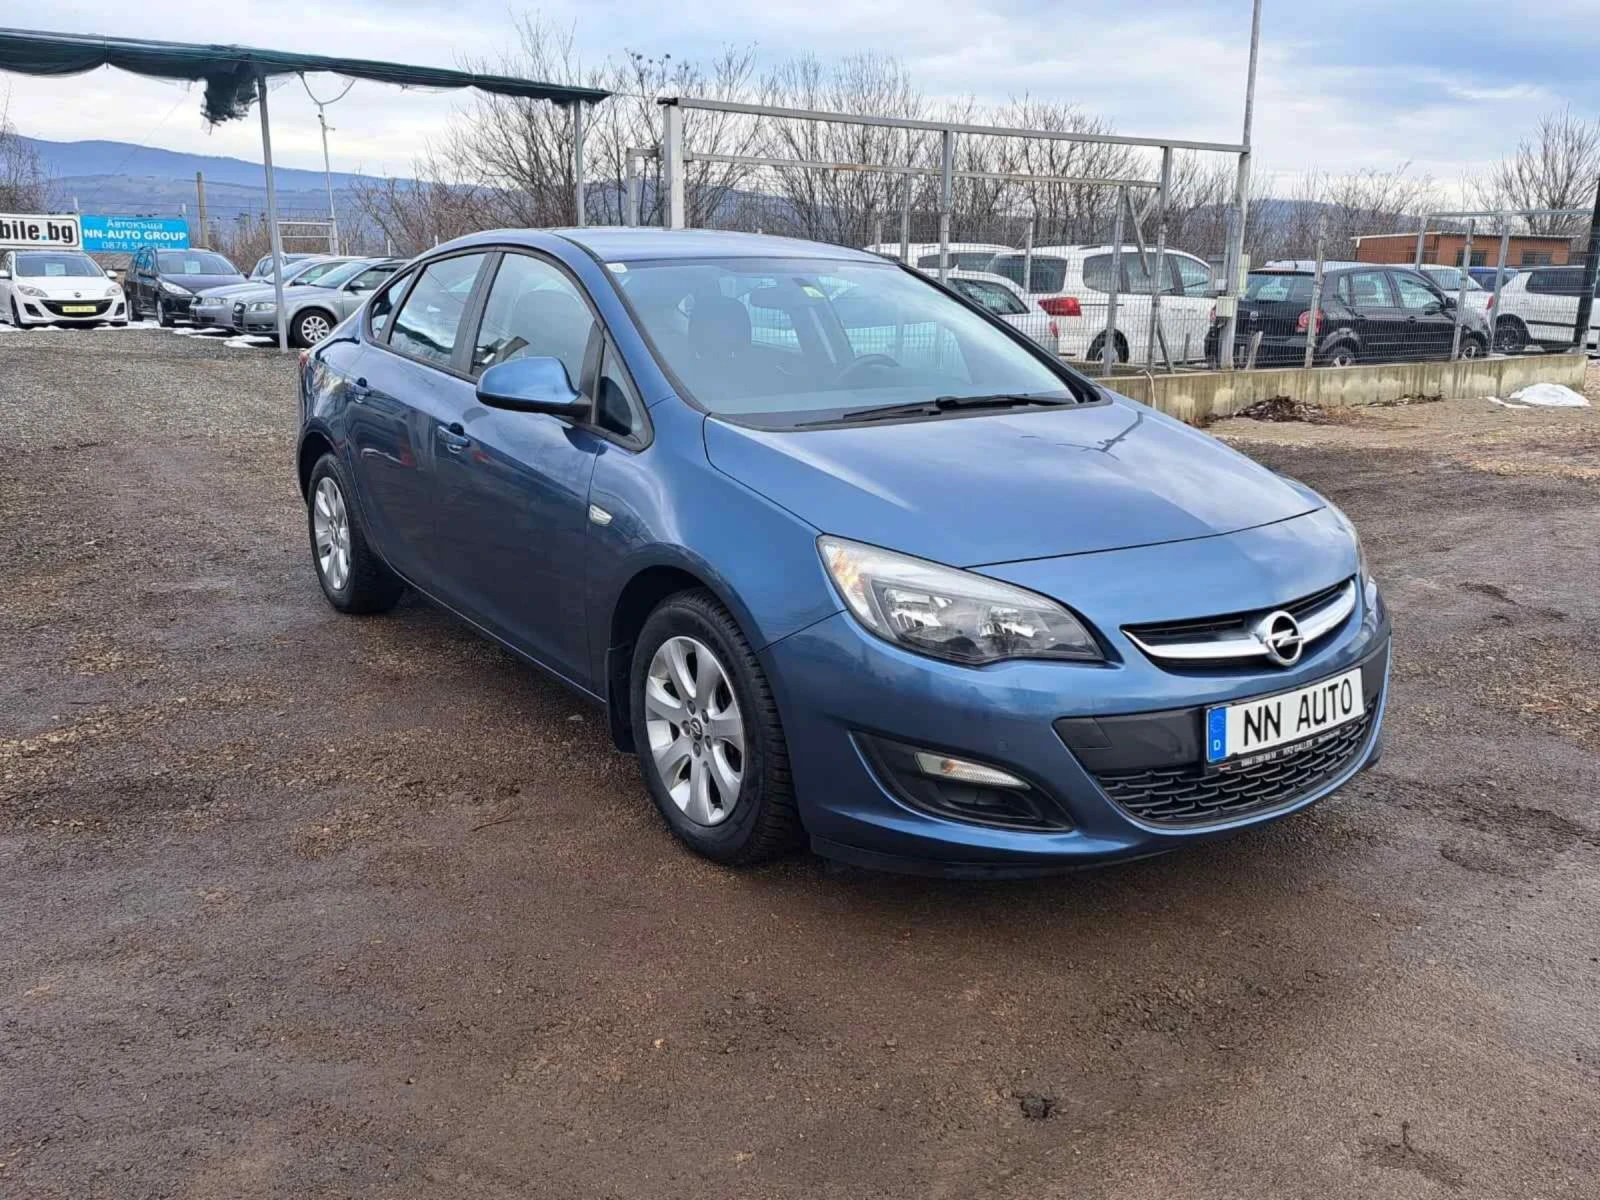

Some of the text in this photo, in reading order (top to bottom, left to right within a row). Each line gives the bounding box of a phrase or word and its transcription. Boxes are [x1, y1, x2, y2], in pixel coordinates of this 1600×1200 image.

[107, 219, 163, 230] Автокъща
[83, 229, 187, 241] NN-AUTO GROUP
[1243, 678, 1353, 747] NN AUTO
[1213, 740, 1221, 751] D
